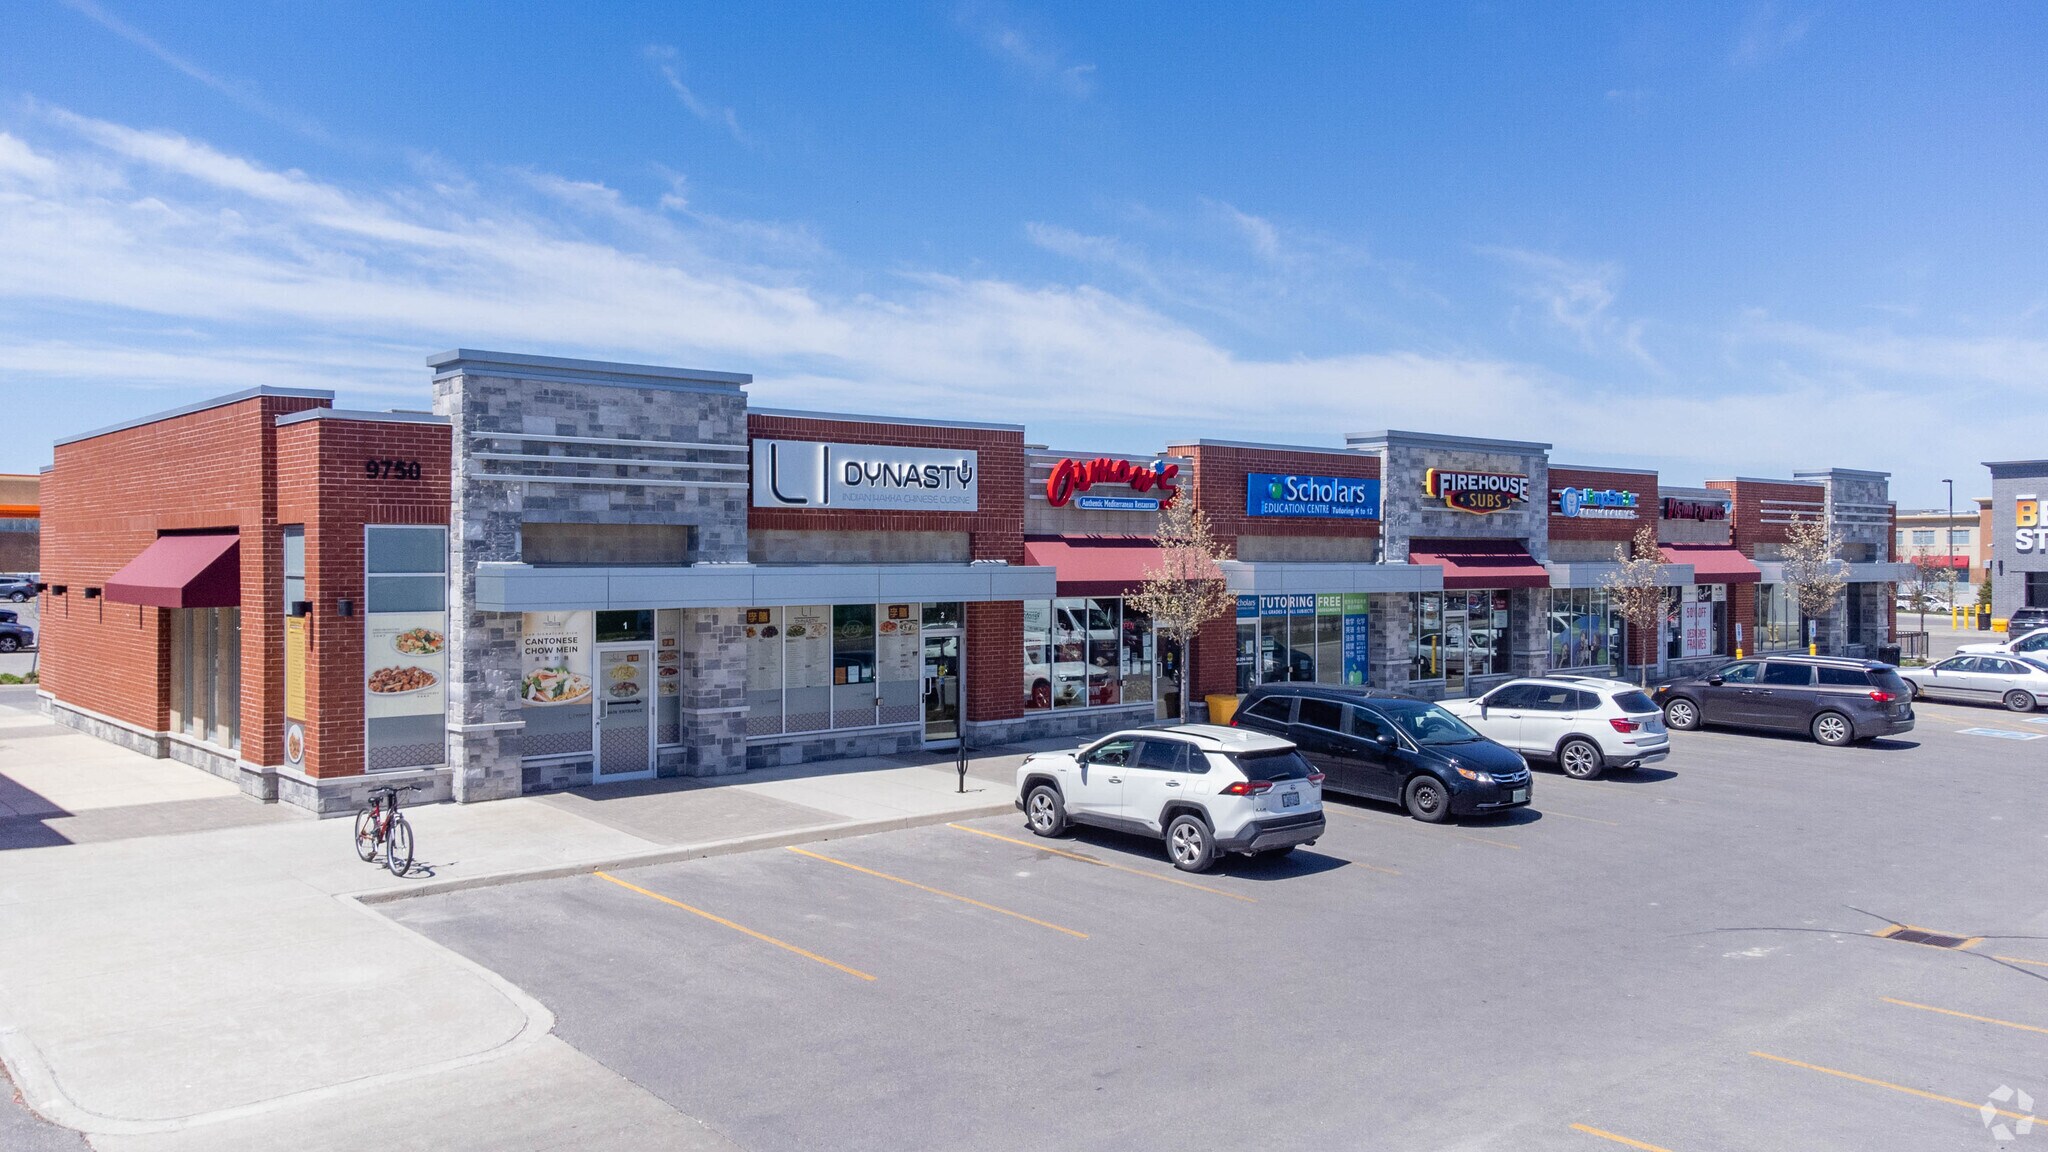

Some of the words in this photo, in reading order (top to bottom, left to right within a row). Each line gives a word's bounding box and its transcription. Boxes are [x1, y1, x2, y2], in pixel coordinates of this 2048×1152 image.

[366, 460, 421, 480] 9750
[844, 460, 973, 489] DYNASTY
[1286, 476, 1365, 503] Scholars
[1440, 473, 1529, 501] FIREHOUSE
[842, 493, 871, 502] INDIAN
[903, 494, 938, 504] CHINESE
[939, 495, 970, 505] CUISINE
[1082, 498, 1103, 507] Authentic
[1104, 499, 1134, 508] Mediterranean
[1135, 500, 1157, 509] Restaurant
[1469, 493, 1502, 508] SUBS
[1264, 503, 1305, 514] EDUCATION
[1307, 504, 1330, 514] CENTRE
[1332, 507, 1354, 516] Tutoring
[1355, 507, 1360, 515] K
[2015, 528, 2048, 550] ST
[1236, 598, 1256, 607] cholars
[1260, 595, 1314, 609] TUTORING
[1317, 596, 1341, 607] FREE
[940, 611, 945, 619] 2
[622, 621, 628, 630] 1
[1122, 621, 1135, 630] PEN
[1686, 628, 1707, 638] DESNER
[525, 637, 578, 646] CANTONESE
[525, 647, 553, 655] CHOW
